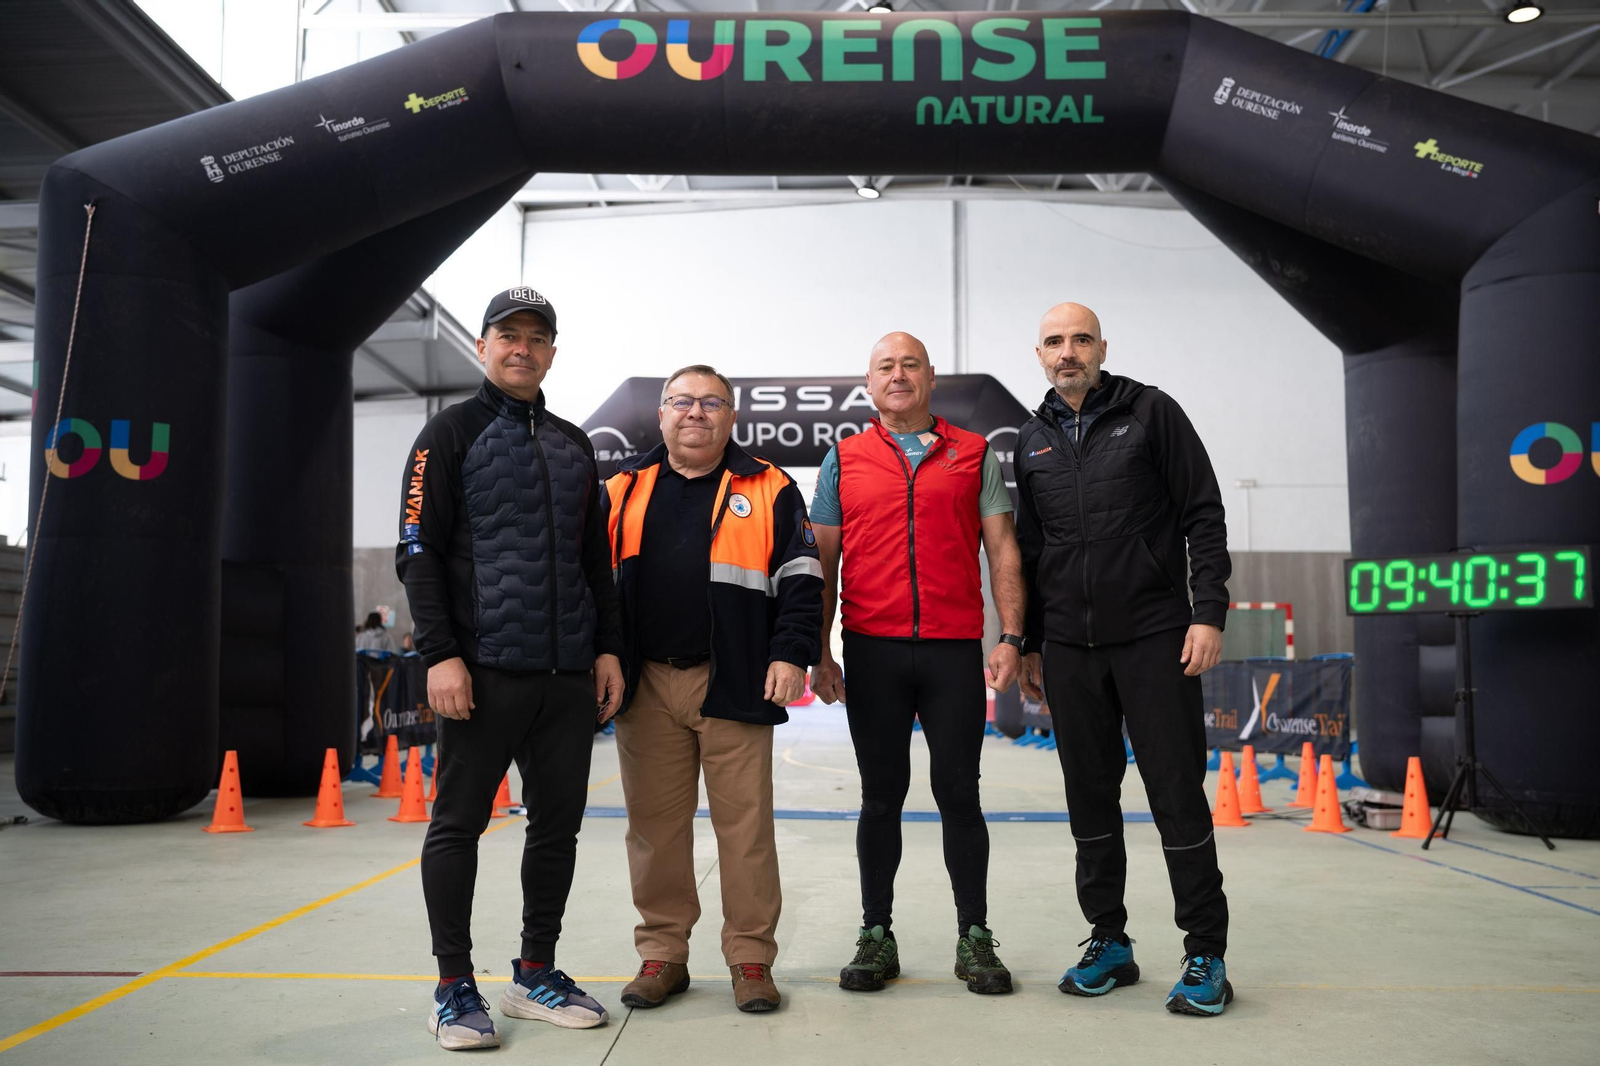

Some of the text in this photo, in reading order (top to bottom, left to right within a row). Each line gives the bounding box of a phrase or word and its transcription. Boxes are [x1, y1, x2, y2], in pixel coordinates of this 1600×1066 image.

[577, 18, 1106, 81] OURENSE
[916, 95, 1104, 125] NATURAL
[1231, 96, 1280, 120] OURENSE
[1236, 86, 1304, 115] DEPUTACIÓN
[222, 135, 295, 165] DEPUTACIÓN
[228, 151, 283, 175] OURENSE
[734, 386, 878, 411] ISSA
[45, 417, 171, 481] OU
[732, 422, 803, 447] UPO
[1350, 551, 1585, 612] 09:40:37
